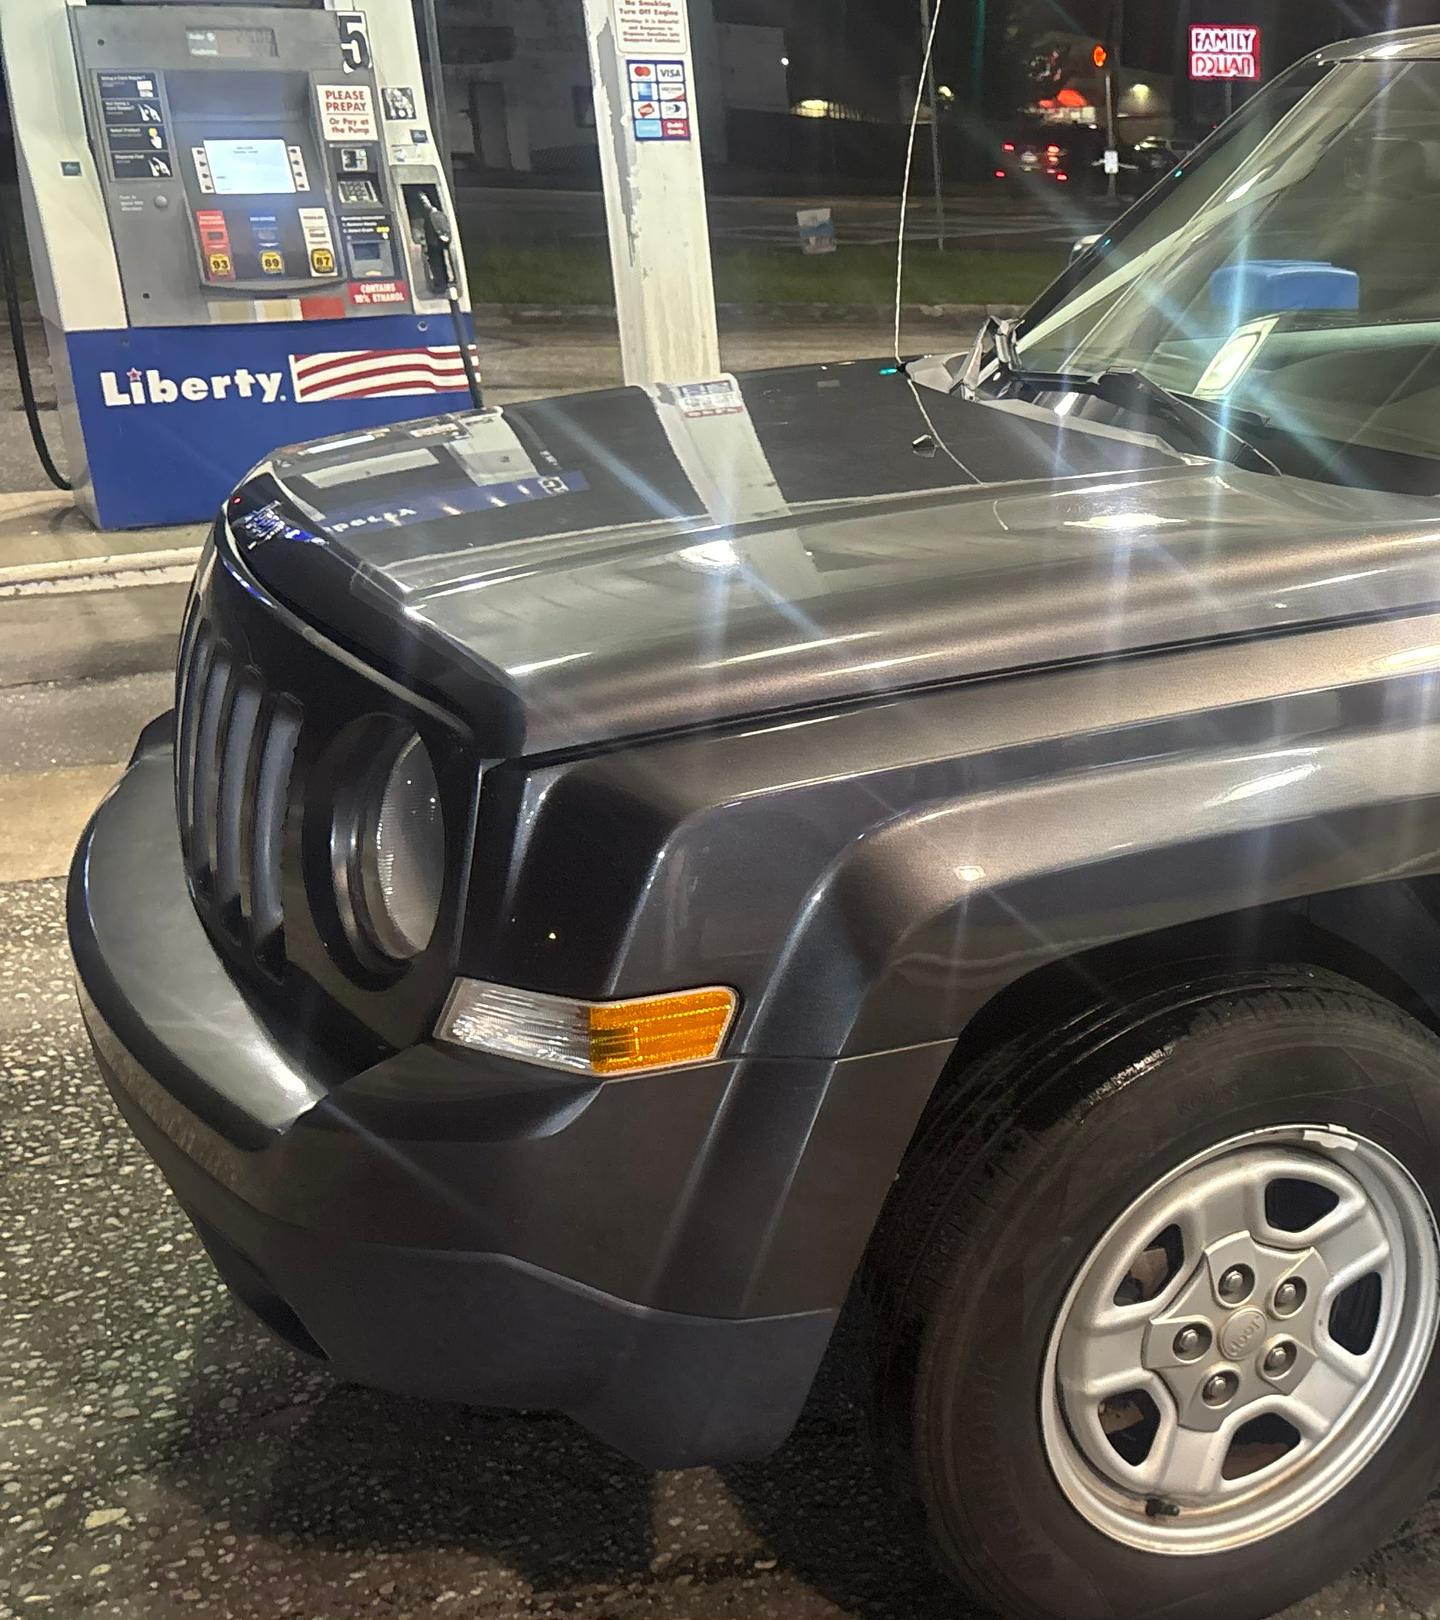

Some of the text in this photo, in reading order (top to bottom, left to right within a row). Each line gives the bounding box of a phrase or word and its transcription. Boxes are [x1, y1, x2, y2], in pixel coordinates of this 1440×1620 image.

[639, 0, 671, 8] Smoking
[653, 9, 678, 17] Engine
[339, 15, 370, 71] 5
[1191, 28, 1256, 52] FAMILY
[1191, 53, 1255, 77] DOLLAR
[660, 69, 681, 78] VISA
[325, 90, 365, 101] PLEASE
[325, 102, 367, 112] PREPAY
[329, 117, 339, 125] Or
[343, 117, 357, 127] Pay
[348, 126, 370, 135] Pump
[212, 259, 229, 270] 93
[264, 258, 280, 268] 89
[316, 256, 330, 266] 87
[360, 282, 396, 294] CONTAINS
[372, 292, 405, 303] ETHANOL
